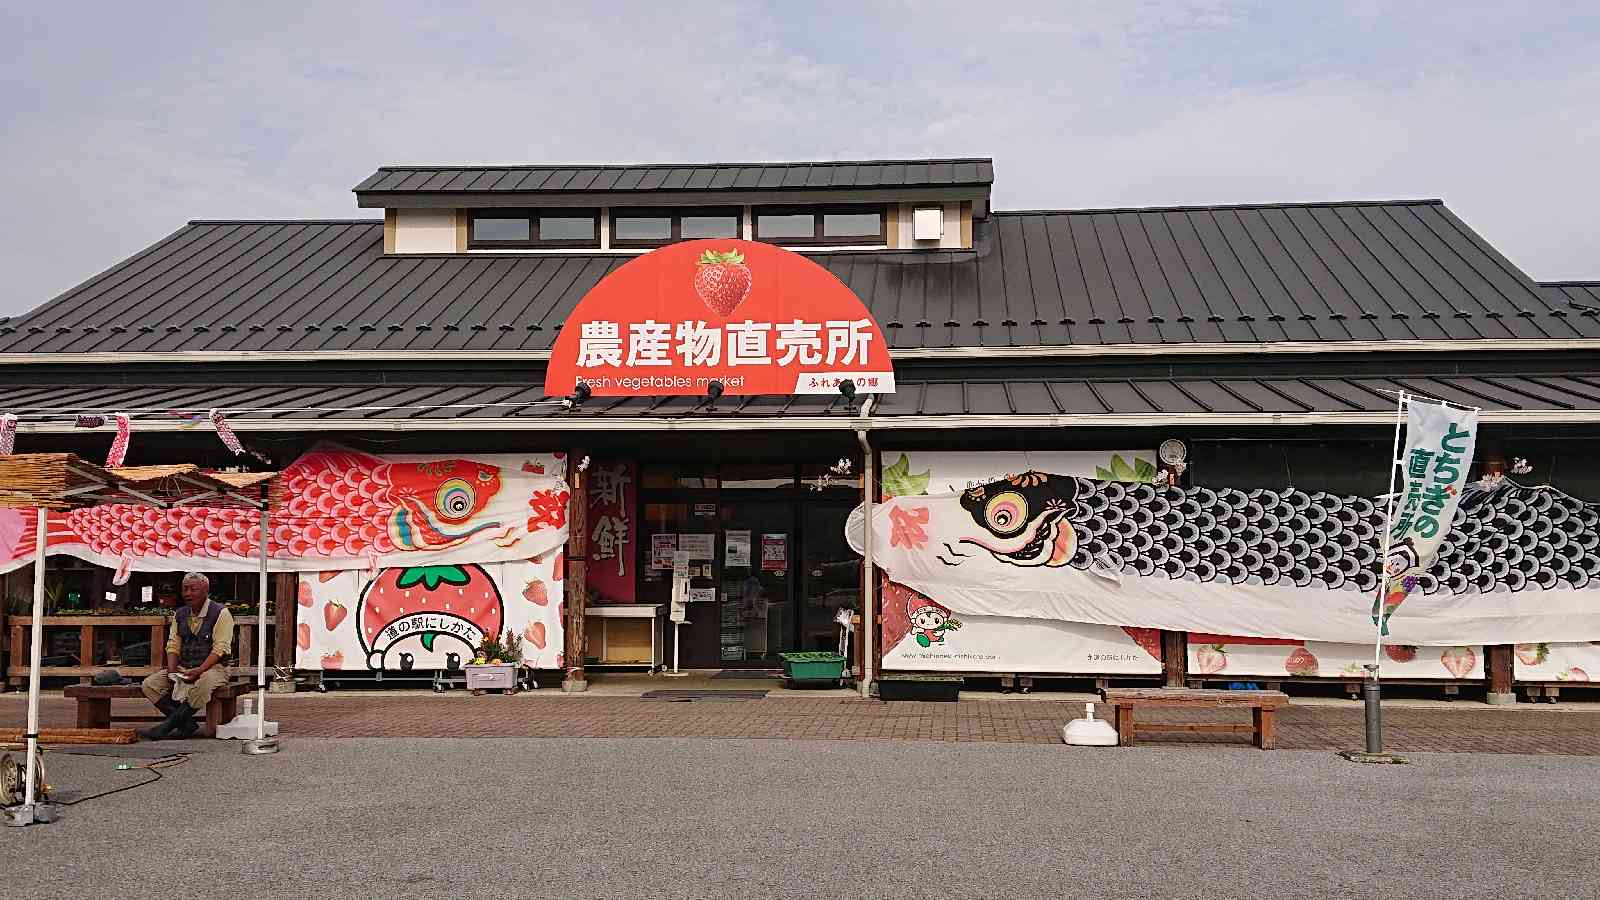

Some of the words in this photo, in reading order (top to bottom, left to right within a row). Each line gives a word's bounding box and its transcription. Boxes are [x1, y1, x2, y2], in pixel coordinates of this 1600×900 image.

[575, 318, 873, 368] 農産物直売所
[575, 375, 612, 388] Fresh
[616, 375, 691, 391] vegetables
[808, 377, 879, 388] ふれあの郷
[1414, 422, 1471, 539] とちぎの
[590, 464, 631, 577] 新鮮
[385, 616, 477, 641] 道の駅にしかた
